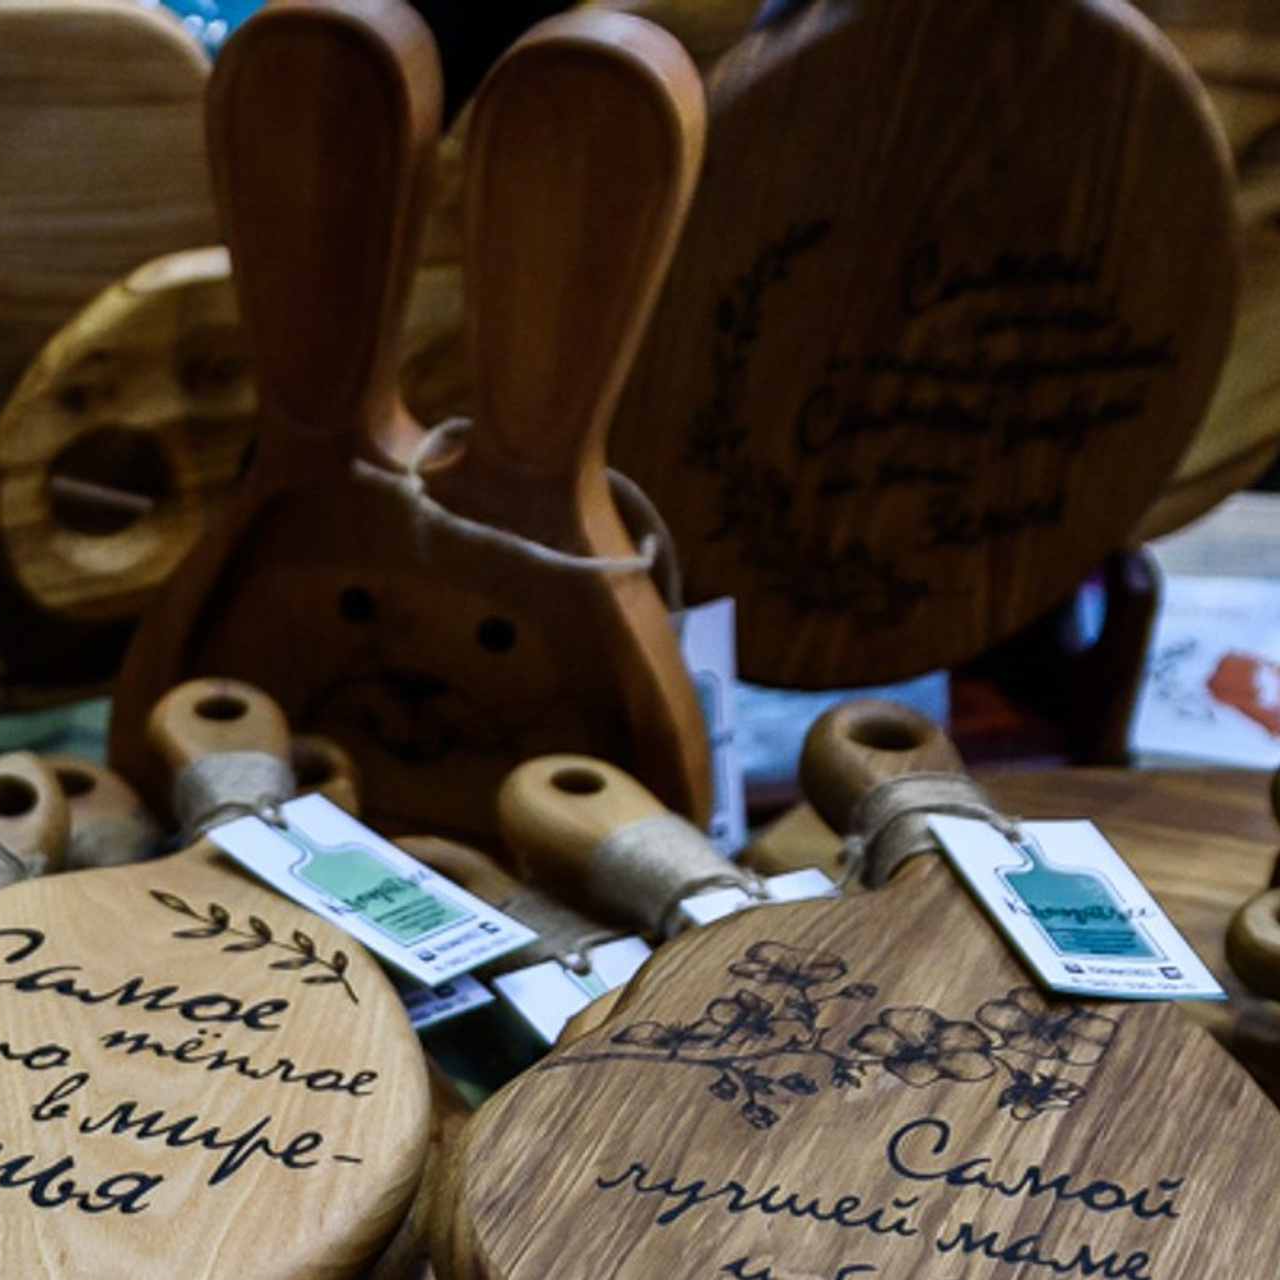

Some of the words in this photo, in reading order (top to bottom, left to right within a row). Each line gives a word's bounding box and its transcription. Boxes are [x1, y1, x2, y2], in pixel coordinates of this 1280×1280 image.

[32, 1073, 89, 1122] в
[100, 1030, 378, 1097] тёплое
[597, 1162, 919, 1237] лучшей
[887, 1117, 1184, 1220] Самой
